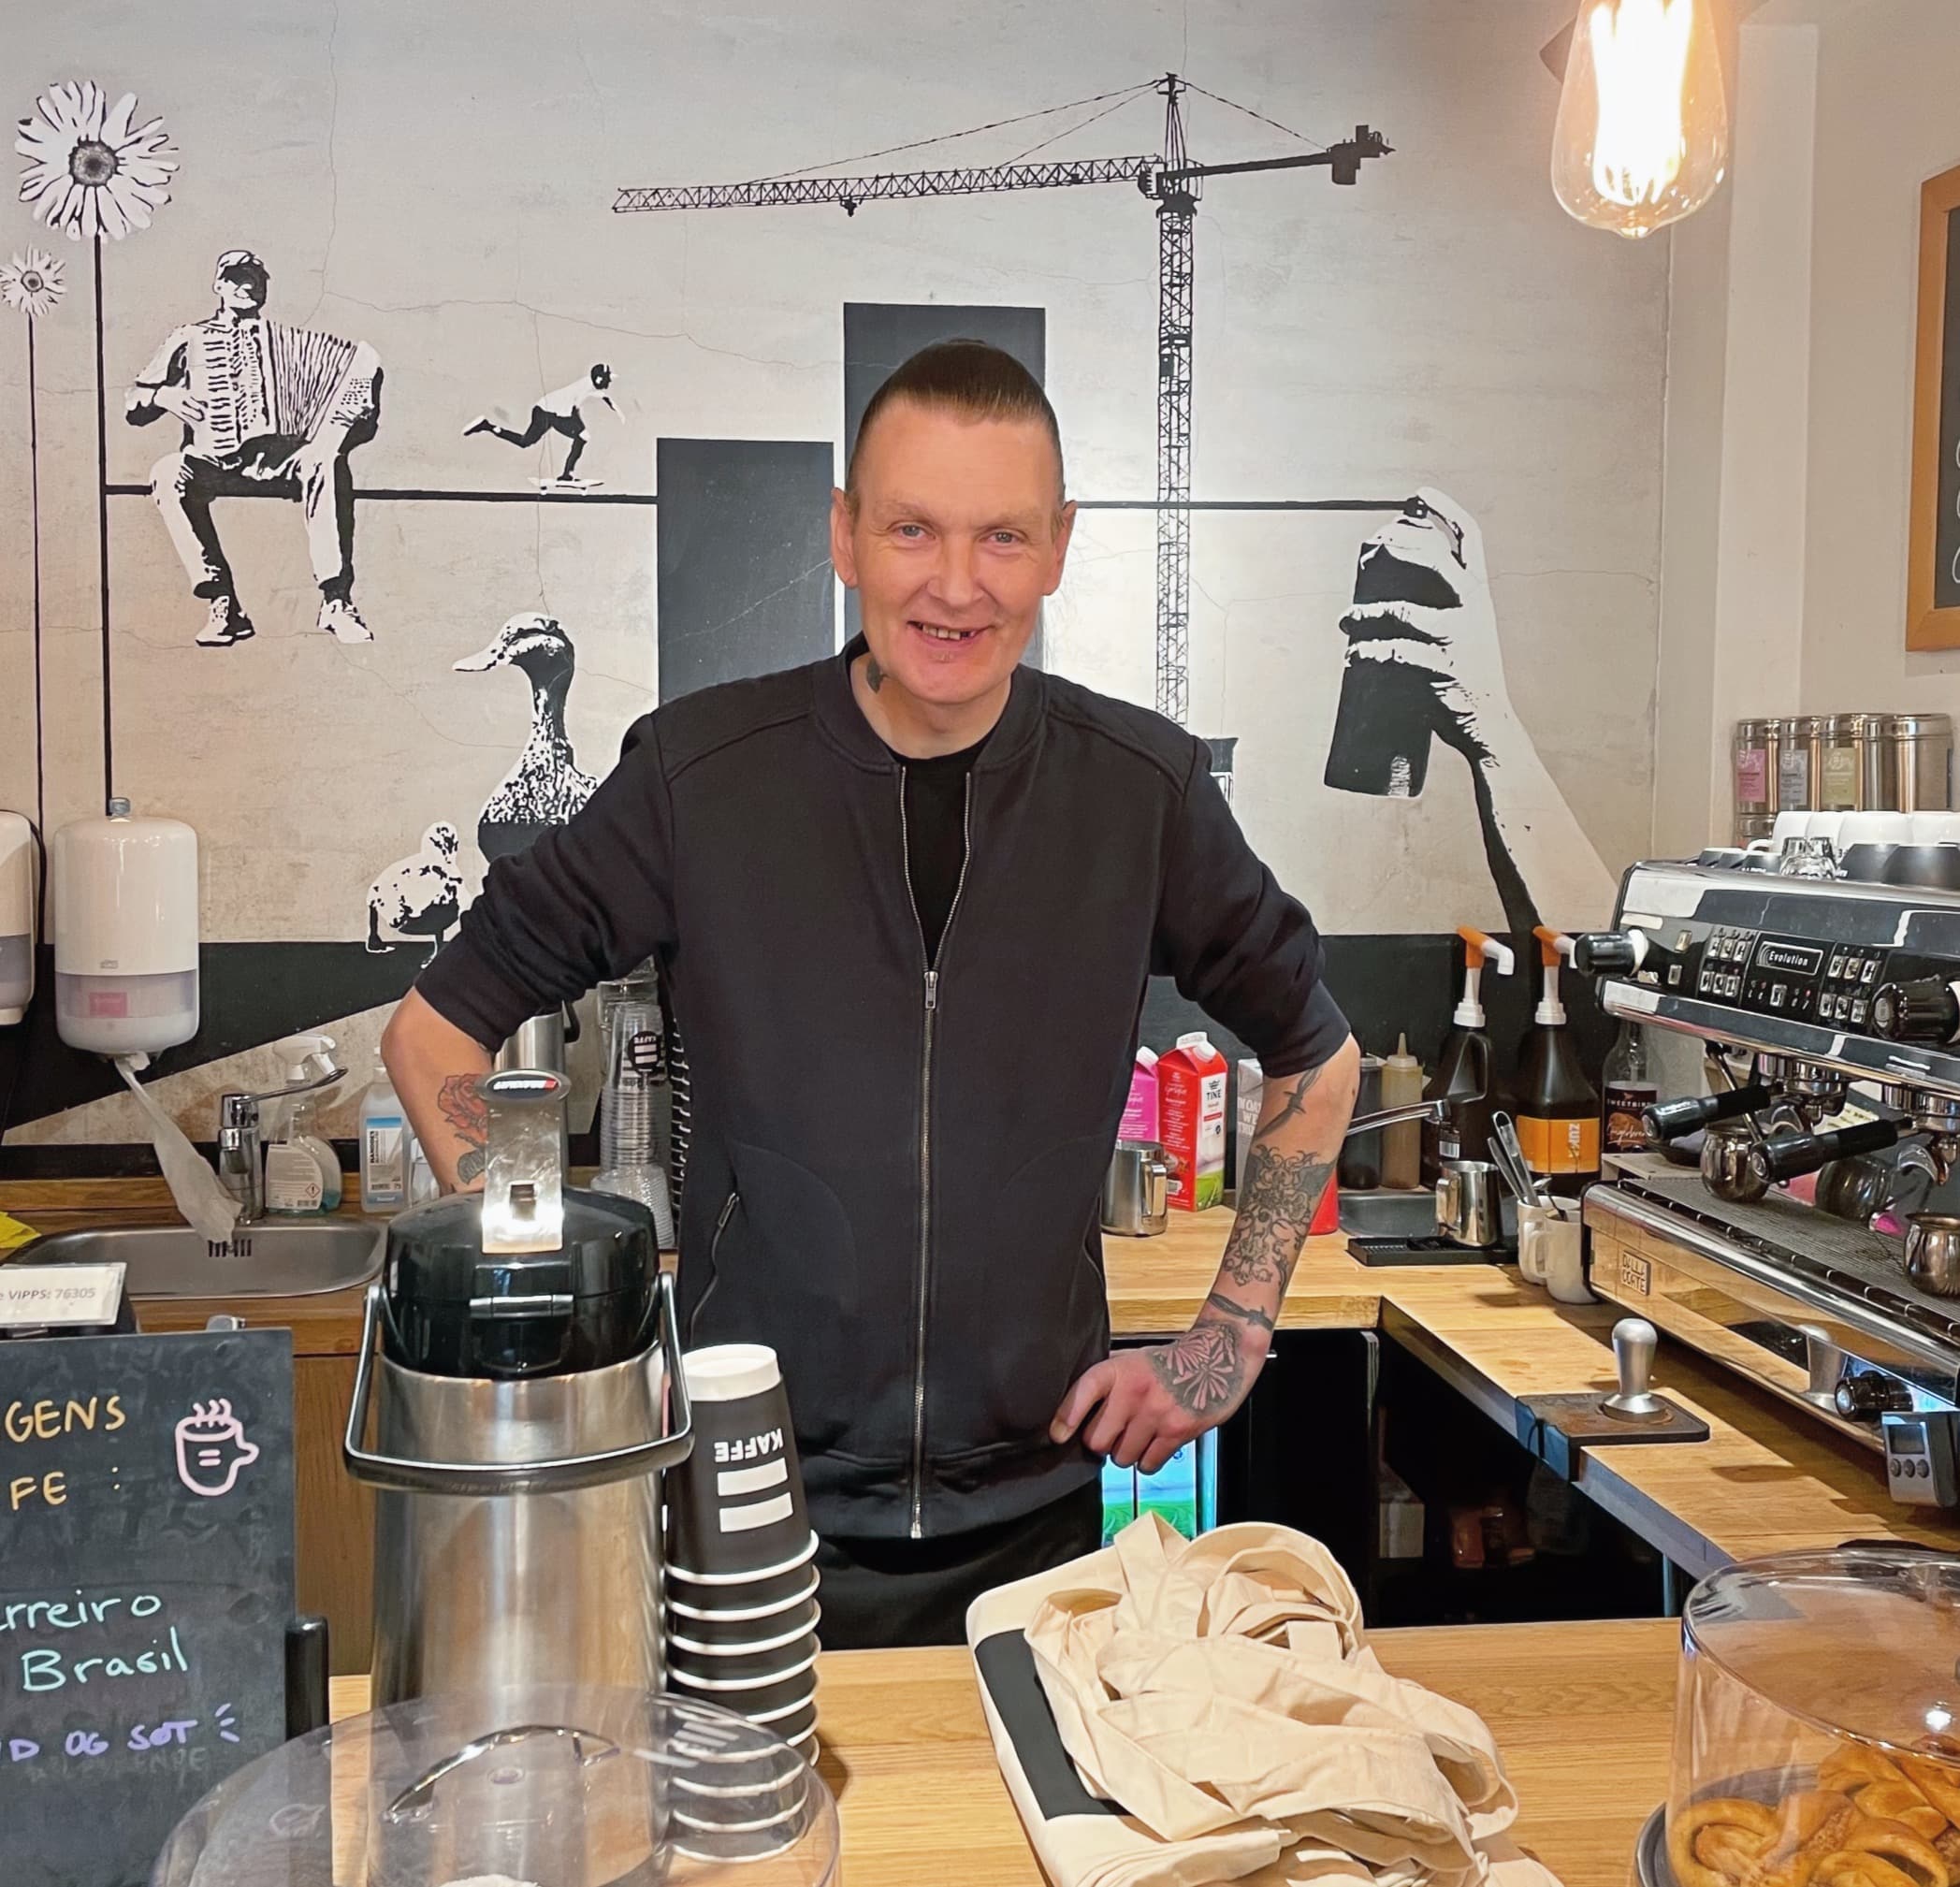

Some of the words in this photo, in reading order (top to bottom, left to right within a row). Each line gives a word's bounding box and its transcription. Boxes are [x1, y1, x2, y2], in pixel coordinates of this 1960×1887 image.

[1768, 951, 1808, 966] Evolution
[1206, 1089, 1222, 1101] TINE
[8, 1288, 51, 1300] VIPPS:
[54, 1286, 96, 1299] 76305
[714, 1428, 784, 1463] KAFFE
[0, 1589, 161, 1631] rreiro
[21, 1626, 188, 1691] Brasil
[65, 1730, 109, 1756] OG
